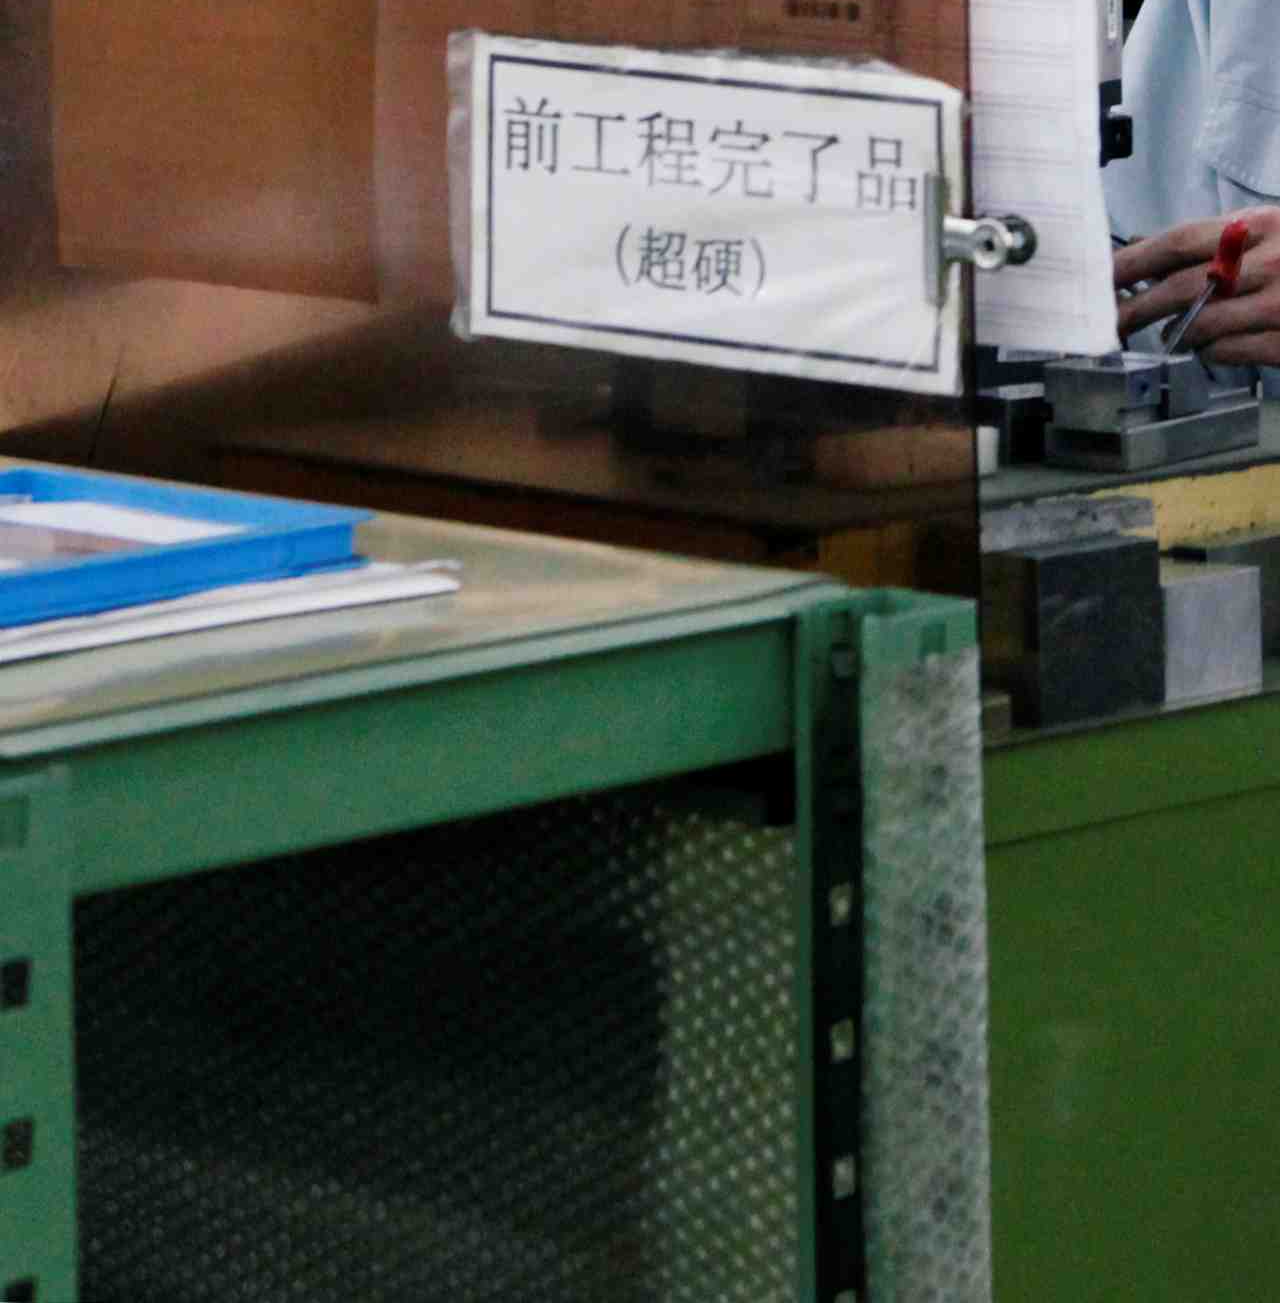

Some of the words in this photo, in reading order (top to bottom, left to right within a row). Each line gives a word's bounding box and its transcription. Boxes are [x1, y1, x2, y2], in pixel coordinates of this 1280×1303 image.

[504, 97, 918, 210] 前工程完了品
[615, 223, 767, 298] (超硬)
